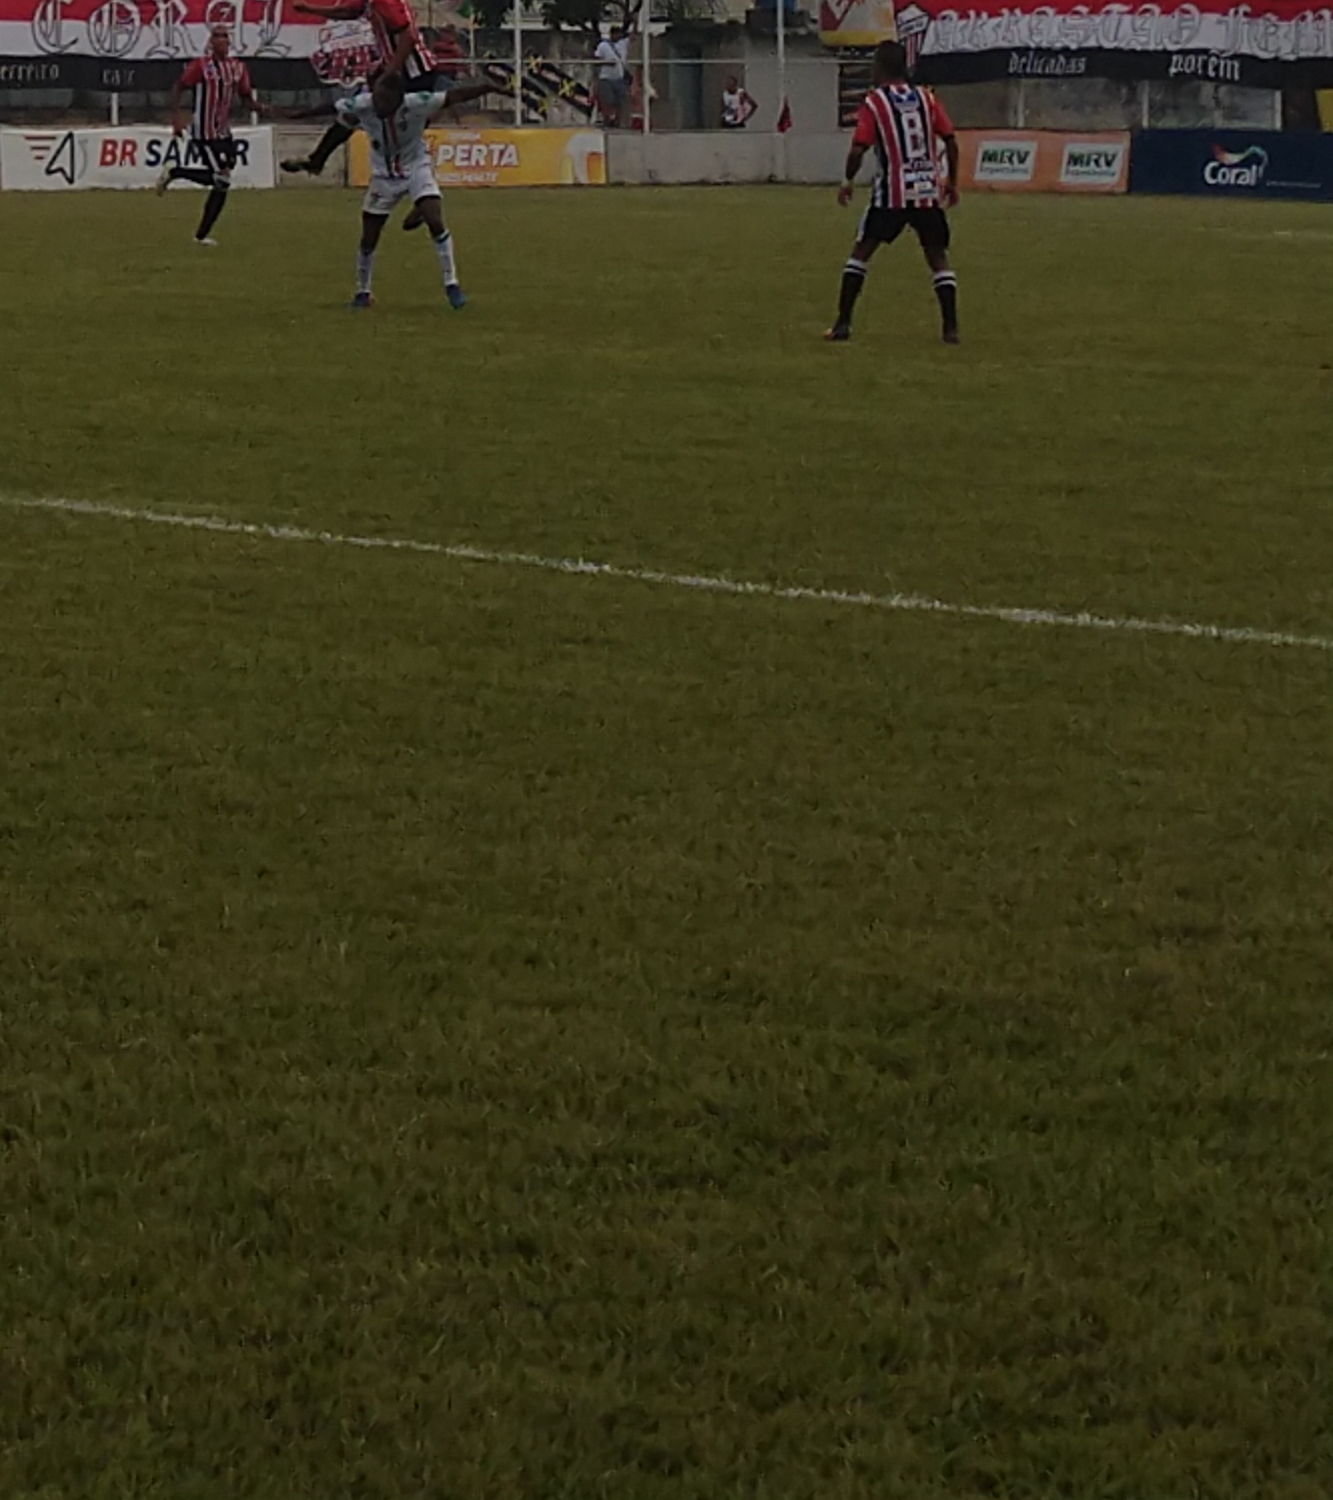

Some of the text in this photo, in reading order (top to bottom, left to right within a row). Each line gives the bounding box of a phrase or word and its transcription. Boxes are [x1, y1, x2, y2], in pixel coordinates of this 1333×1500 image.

[1007, 50, 1087, 76] delicadas
[901, 112, 928, 158] 8
[98, 138, 250, 167] BR SAMR
[436, 143, 519, 168] PERTA
[981, 148, 1031, 166] MRV
[1066, 151, 1118, 168] MRV
[1203, 160, 1258, 186] Coral
